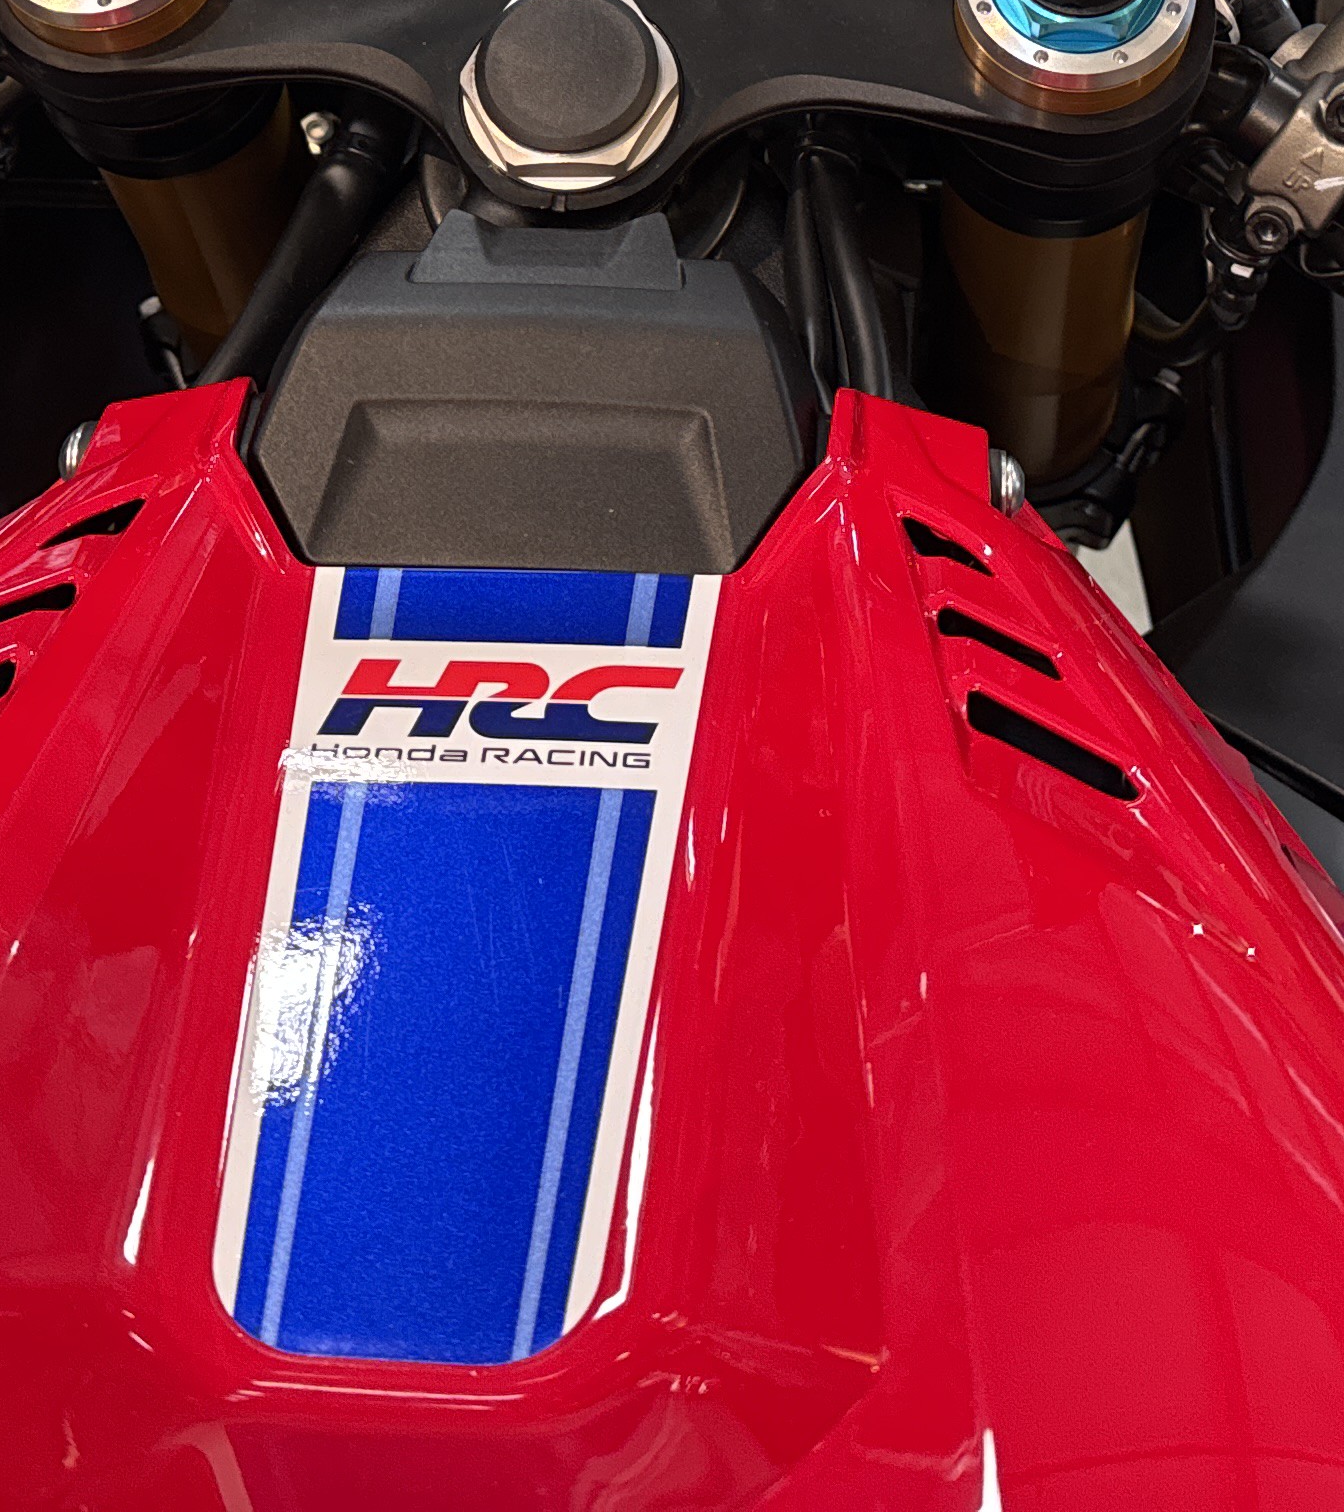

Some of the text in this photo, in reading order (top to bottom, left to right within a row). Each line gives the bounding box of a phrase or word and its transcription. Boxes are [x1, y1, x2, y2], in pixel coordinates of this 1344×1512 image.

[1283, 169, 1311, 192] UP
[317, 659, 685, 744] HRC
[311, 743, 652, 769] Honda RACING
